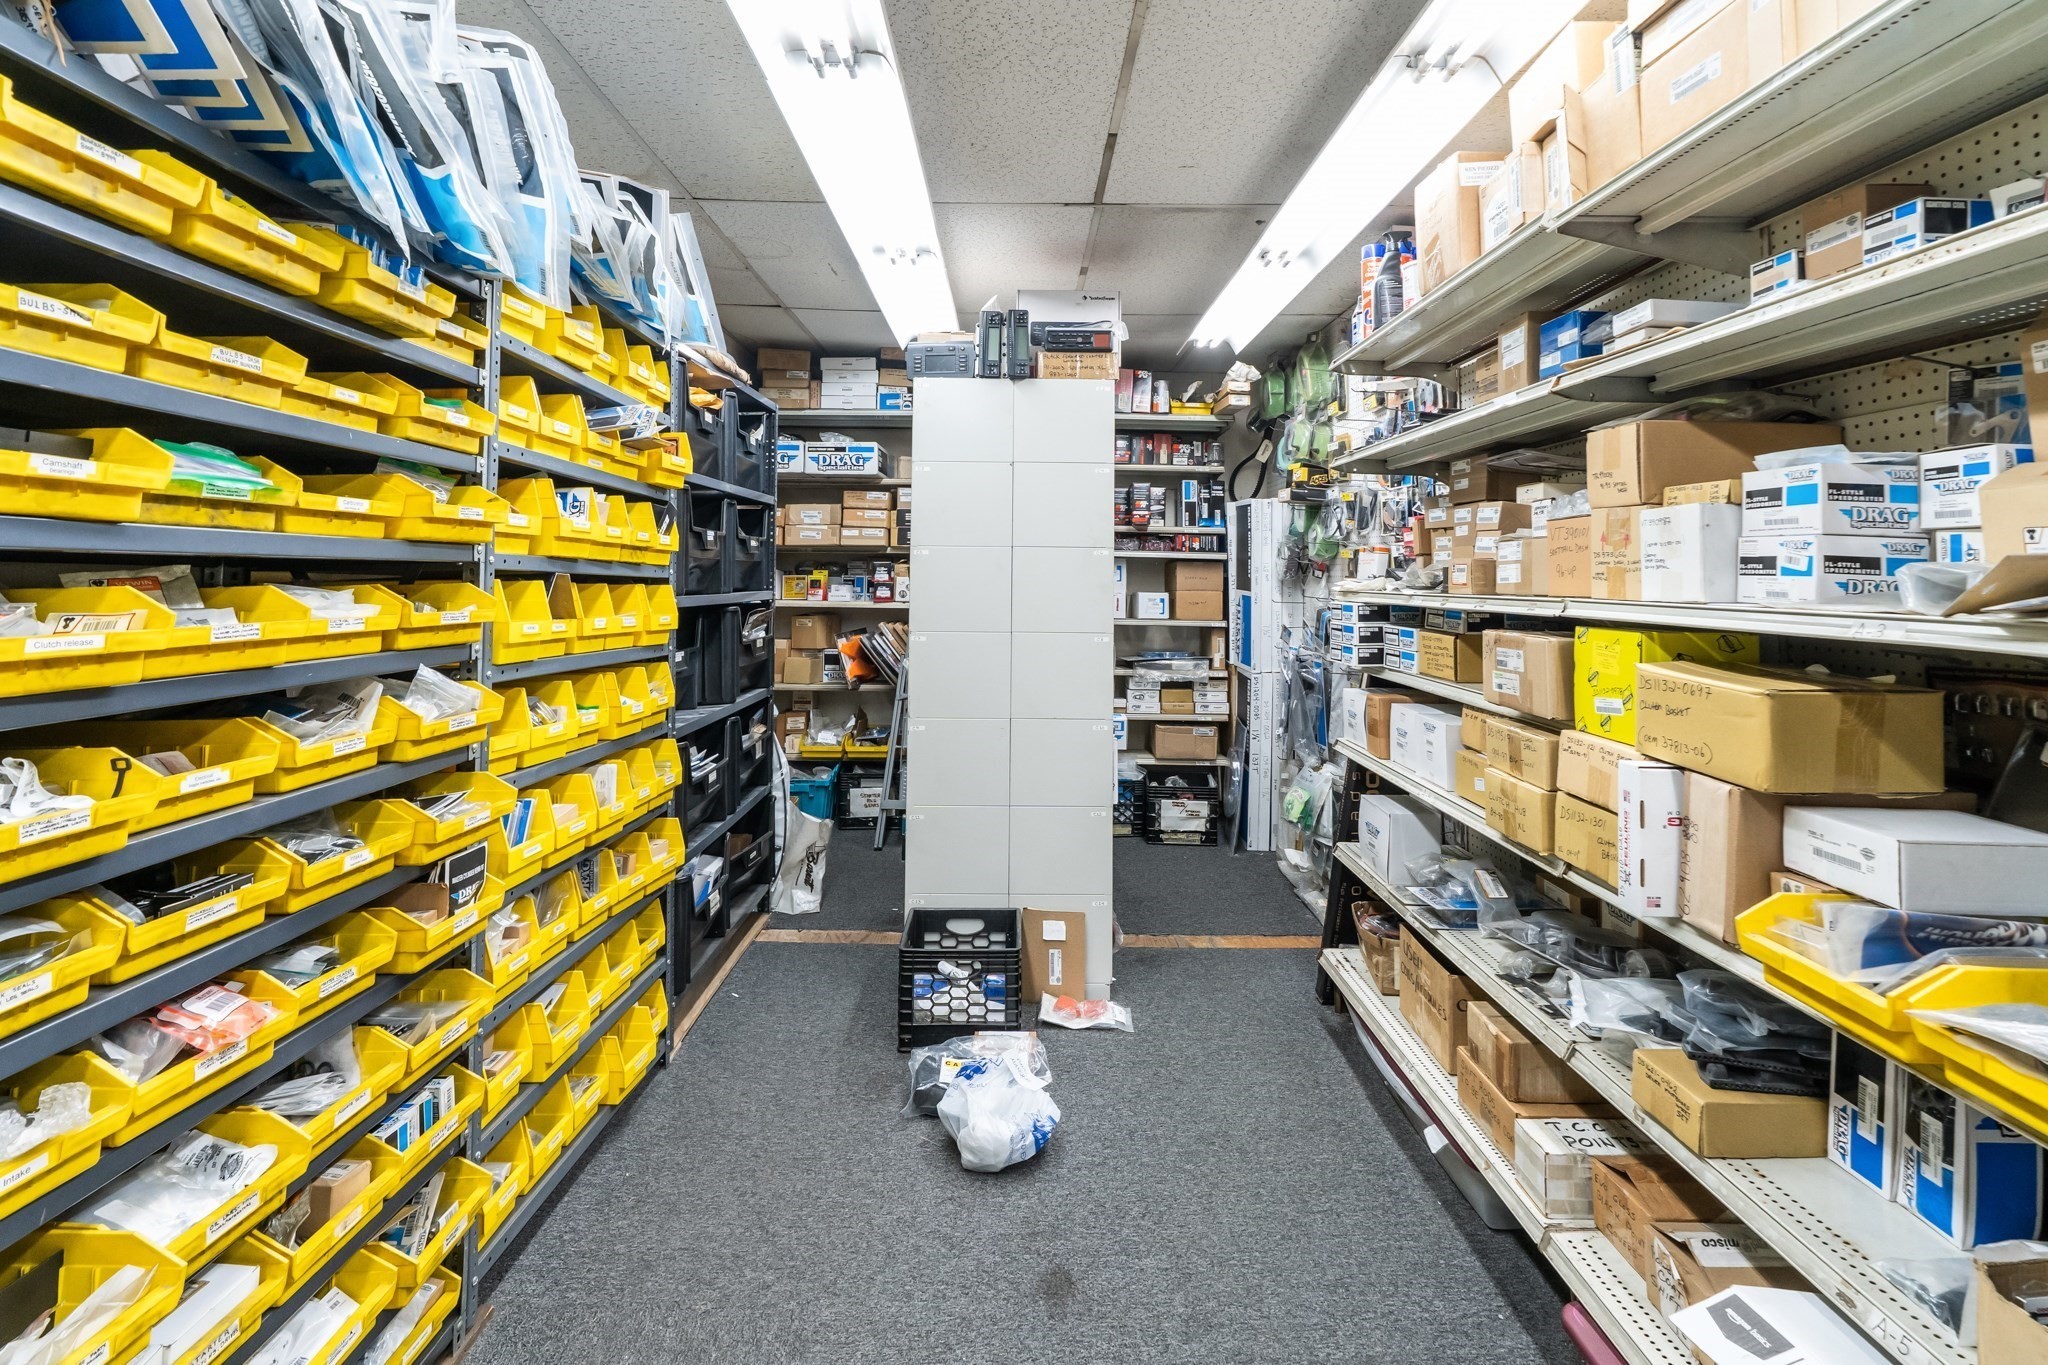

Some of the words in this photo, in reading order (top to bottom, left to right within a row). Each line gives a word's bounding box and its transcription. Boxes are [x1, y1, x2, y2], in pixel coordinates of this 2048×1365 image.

[42, 457, 84, 471] Camshaft
[817, 453, 865, 468] DRAG
[1787, 470, 1816, 481] DRAG
[1938, 479, 1975, 491] DRAG
[1746, 500, 1783, 509] SPEEDOMETER
[1850, 506, 1909, 524] DRAG
[1850, 520, 1909, 530] Specialties
[1783, 540, 1808, 551] DRAG
[1885, 542, 1920, 553] DRAG
[1825, 568, 1881, 576] SPEEDOMETER
[114, 580, 153, 589] V-TWIN
[1853, 623, 1887, 638] A-3
[33, 641, 62, 651] Clutch
[64, 639, 95, 649] release
[1637, 673, 1714, 700] DS1132-0697
[1837, 1108, 1850, 1158] DRAG
[1562, 1134, 1642, 1151] POINTS
[2, 1165, 31, 1188] Intake
[1872, 1316, 1913, 1356] A-5
[192, 1328, 231, 1363] TARTER
